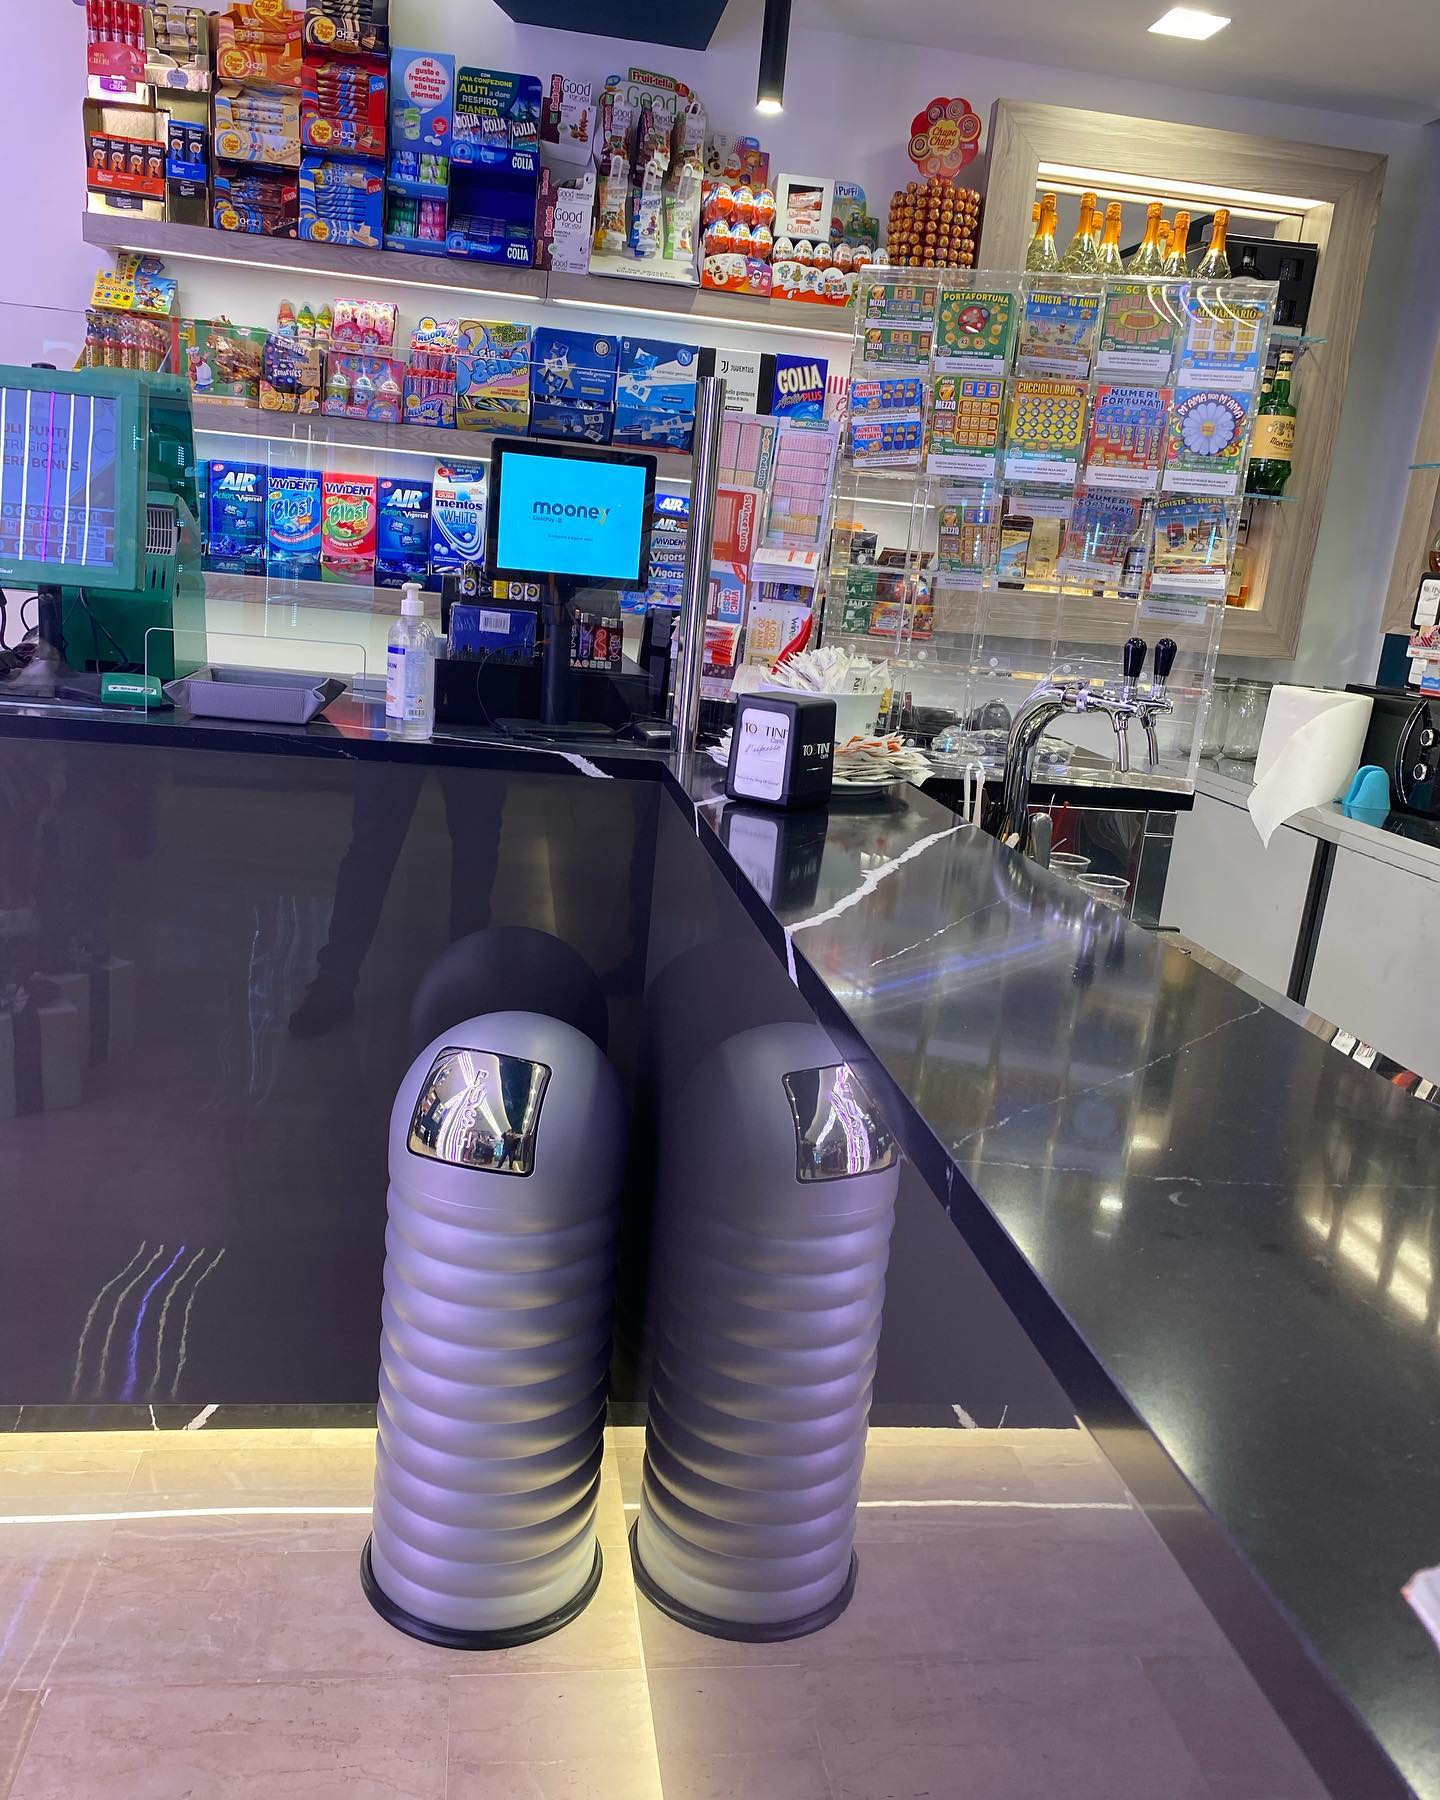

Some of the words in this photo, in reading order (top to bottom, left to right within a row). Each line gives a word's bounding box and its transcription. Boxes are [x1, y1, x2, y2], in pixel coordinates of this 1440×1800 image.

[422, 59, 433, 68] dai
[415, 67, 434, 76] gusto
[408, 74, 446, 85] freschezza
[459, 74, 473, 83] UNA
[474, 77, 513, 88] CONFEZIONE
[631, 70, 674, 90] Fruit-tella
[414, 82, 427, 90] alla
[428, 84, 440, 92] tua
[459, 82, 488, 96] AIUTI
[494, 90, 511, 99] dare
[562, 78, 592, 97] Good
[410, 90, 443, 101] giornata!
[462, 94, 499, 107] RESPIRO
[458, 104, 498, 117] PIANETA
[932, 127, 957, 138] Chupa
[929, 136, 955, 147] Chups
[512, 156, 534, 171] GOLIA
[555, 208, 583, 224] Good
[786, 223, 819, 235] Raffaello
[507, 248, 529, 261] GOLIA
[943, 292, 1009, 305] PORTAFORTUNA
[1030, 294, 1062, 305] TURISTA
[1078, 298, 1098, 308] ANNI
[417, 328, 447, 342] MELODY
[776, 363, 824, 394] GOLIA
[1018, 382, 1053, 394] CUCCIOLI
[1111, 388, 1159, 398] NUMERI
[802, 390, 823, 402] PLUS
[935, 399, 956, 411] MEZZO
[1101, 397, 1164, 410] FORTUNATI
[1177, 393, 1207, 416] M'AMA
[1218, 393, 1245, 419] M'AMA
[219, 471, 257, 493] AIR
[268, 477, 318, 492] VIVIDENT
[325, 482, 373, 496] VIVIDENT
[386, 488, 423, 509] AIR
[435, 499, 483, 511] mentos
[659, 497, 684, 511] AIR
[271, 495, 315, 521] Blast
[327, 498, 371, 526] Blast
[533, 501, 611, 526] mooney
[655, 517, 677, 531] AIR
